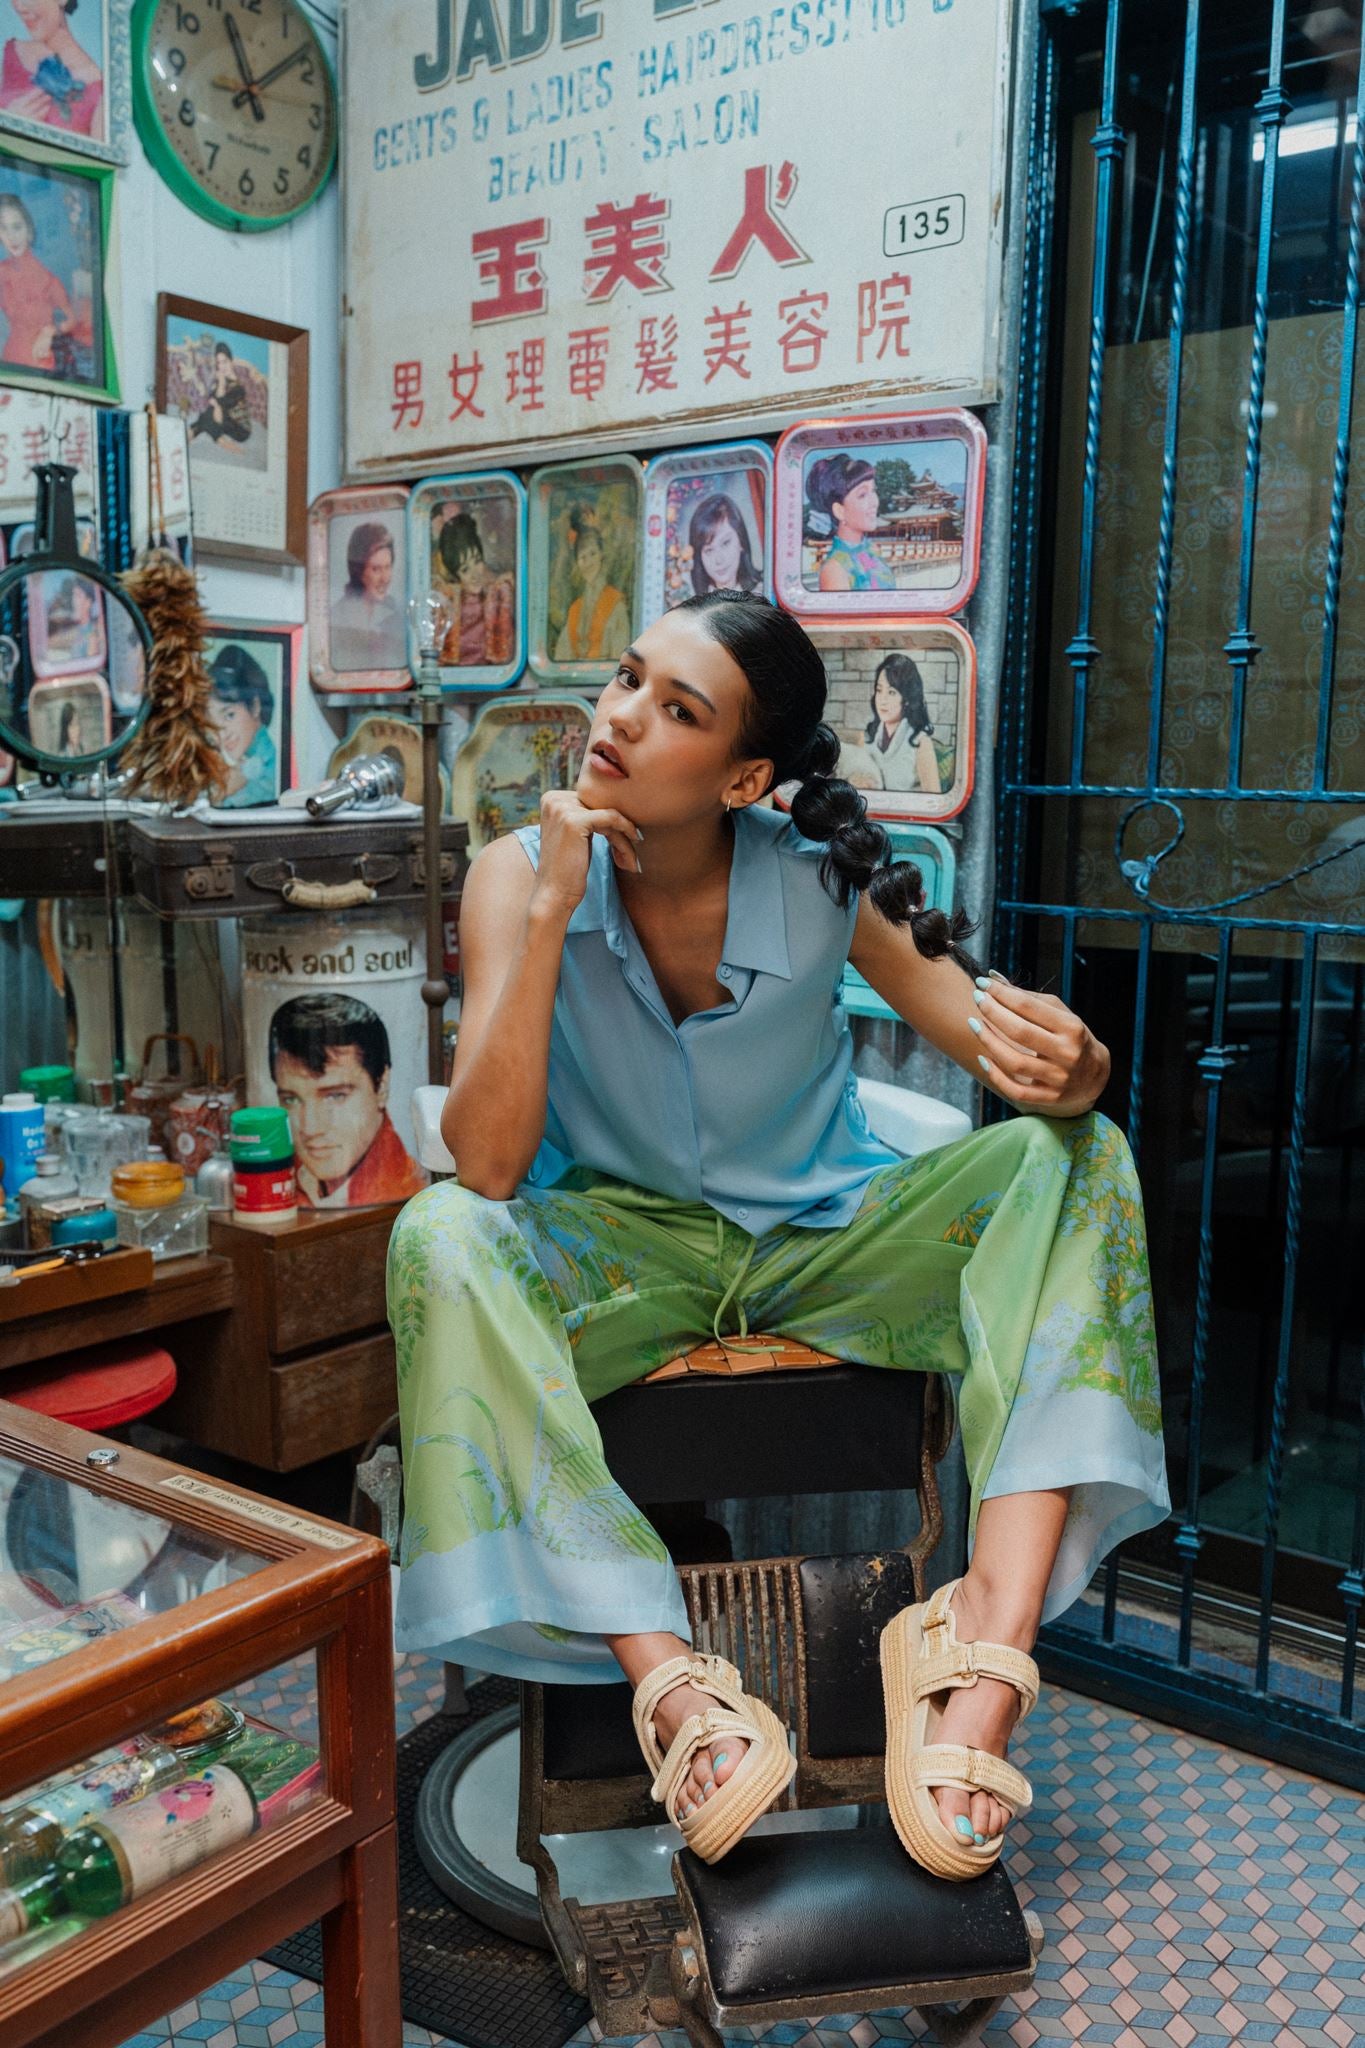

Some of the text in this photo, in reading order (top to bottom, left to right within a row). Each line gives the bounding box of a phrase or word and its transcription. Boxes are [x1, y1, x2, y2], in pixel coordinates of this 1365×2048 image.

[176, 3, 200, 34] 10
[168, 48, 186, 76] 9
[300, 55, 315, 85] 2
[178, 98, 195, 127] 8
[308, 103, 322, 130] 3
[373, 106, 458, 171] GENTS
[506, 60, 613, 136] LADIES
[642, 89, 760, 163] SALON
[204, 141, 220, 170] 7
[297, 146, 311, 169] 4
[238, 168, 254, 195] 6
[273, 168, 290, 194] 5
[898, 206, 950, 244] 135
[471, 160, 810, 326] 玉美人
[390, 272, 911, 431] 男女理電髮美容院
[302, 945, 355, 975] and
[364, 939, 413, 973] soul
